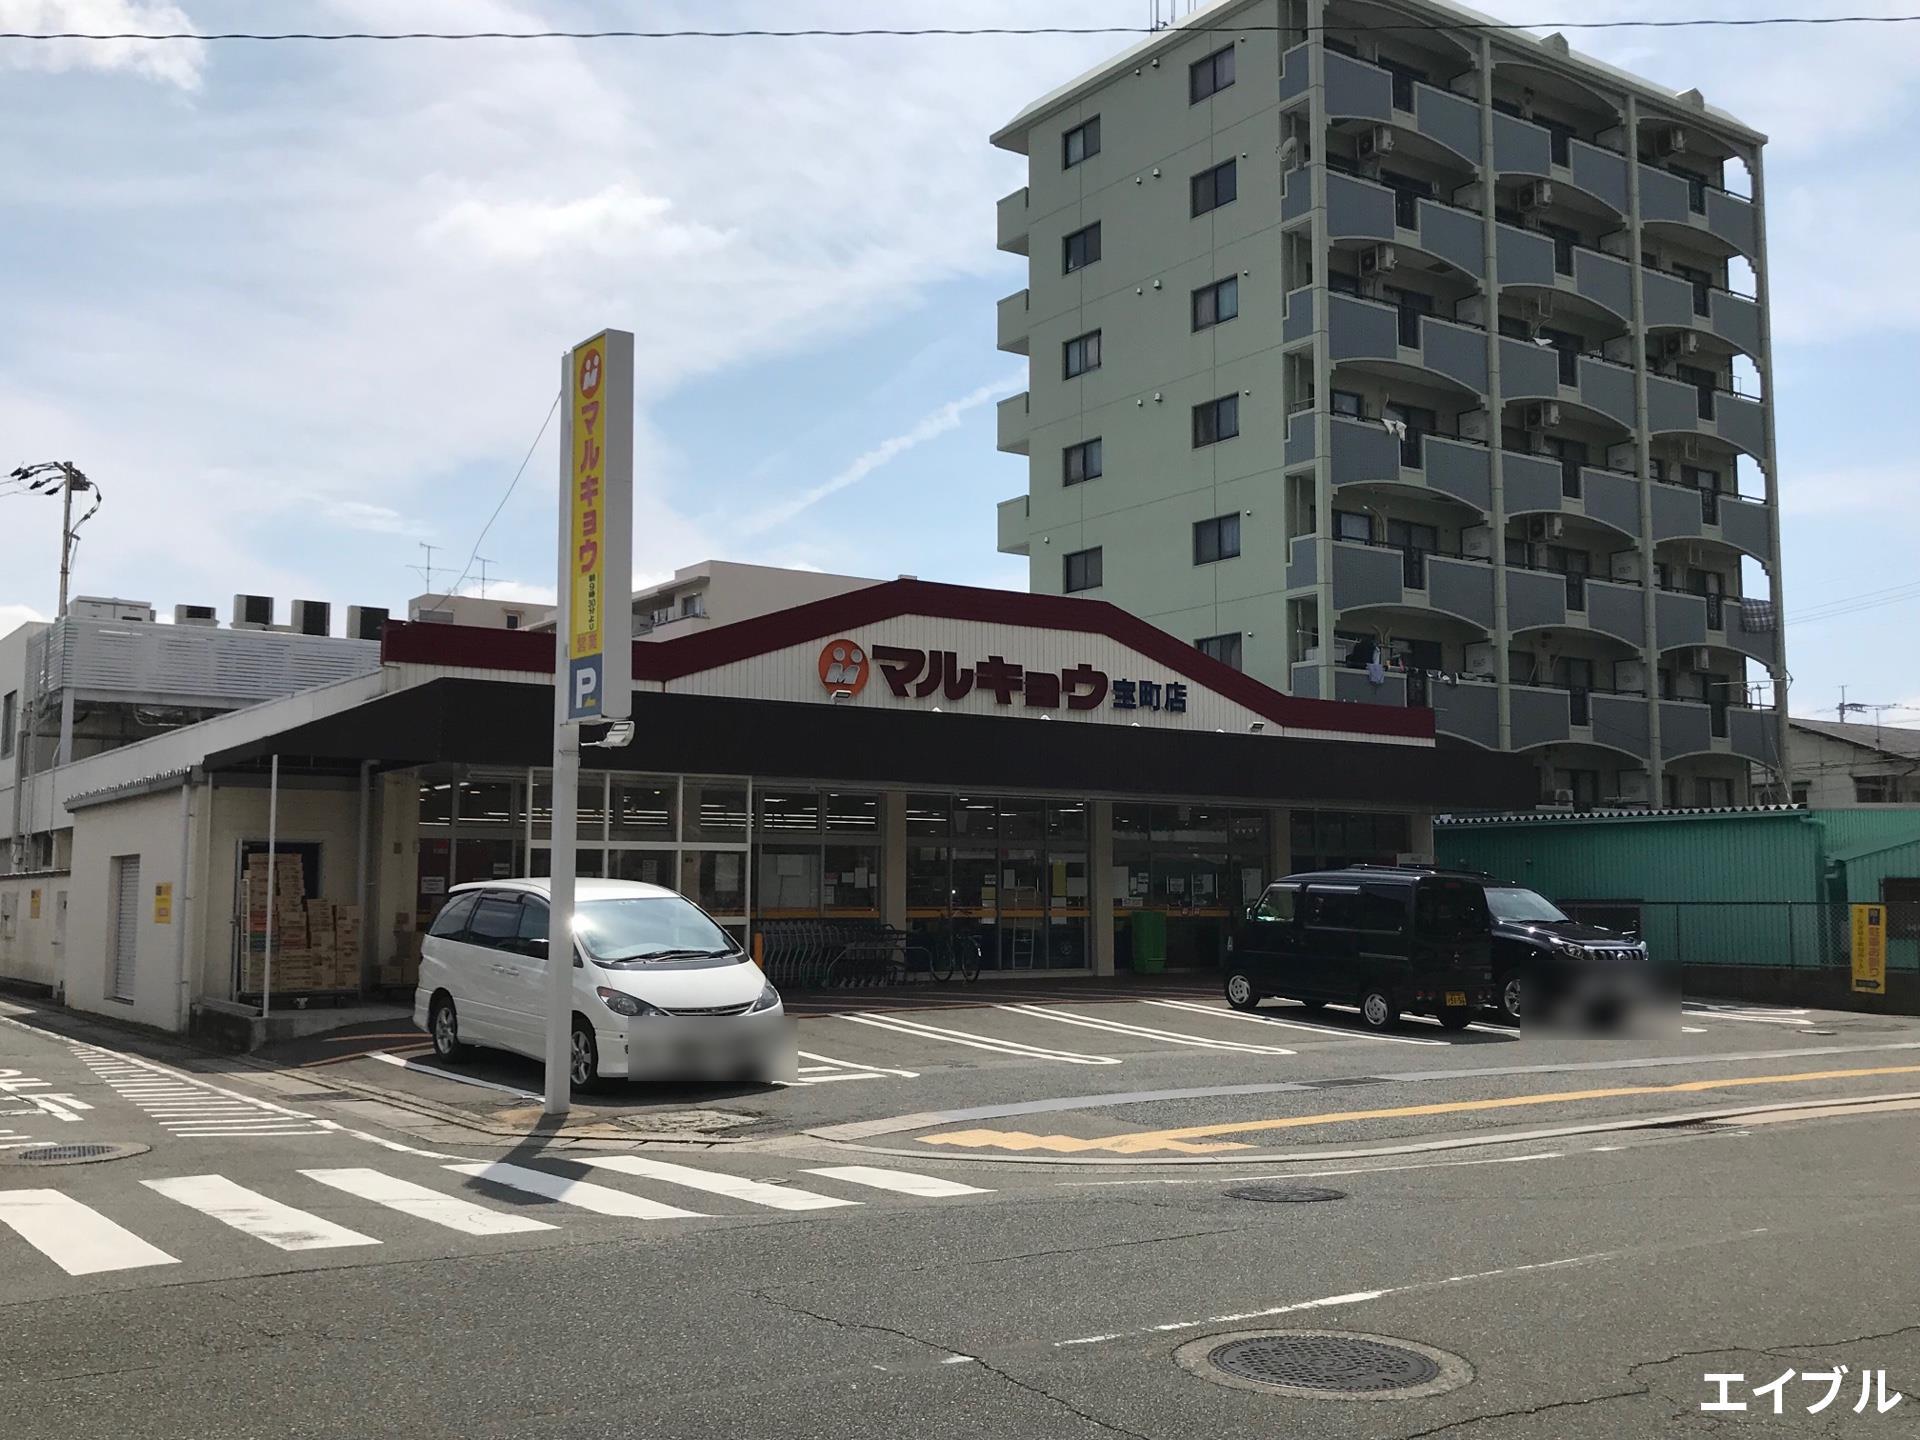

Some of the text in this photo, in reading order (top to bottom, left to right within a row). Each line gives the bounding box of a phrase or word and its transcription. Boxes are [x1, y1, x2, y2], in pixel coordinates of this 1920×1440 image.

[580, 400, 600, 574] マルキョウ
[576, 667, 597, 709] P
[872, 644, 1110, 710] マルキョウ
